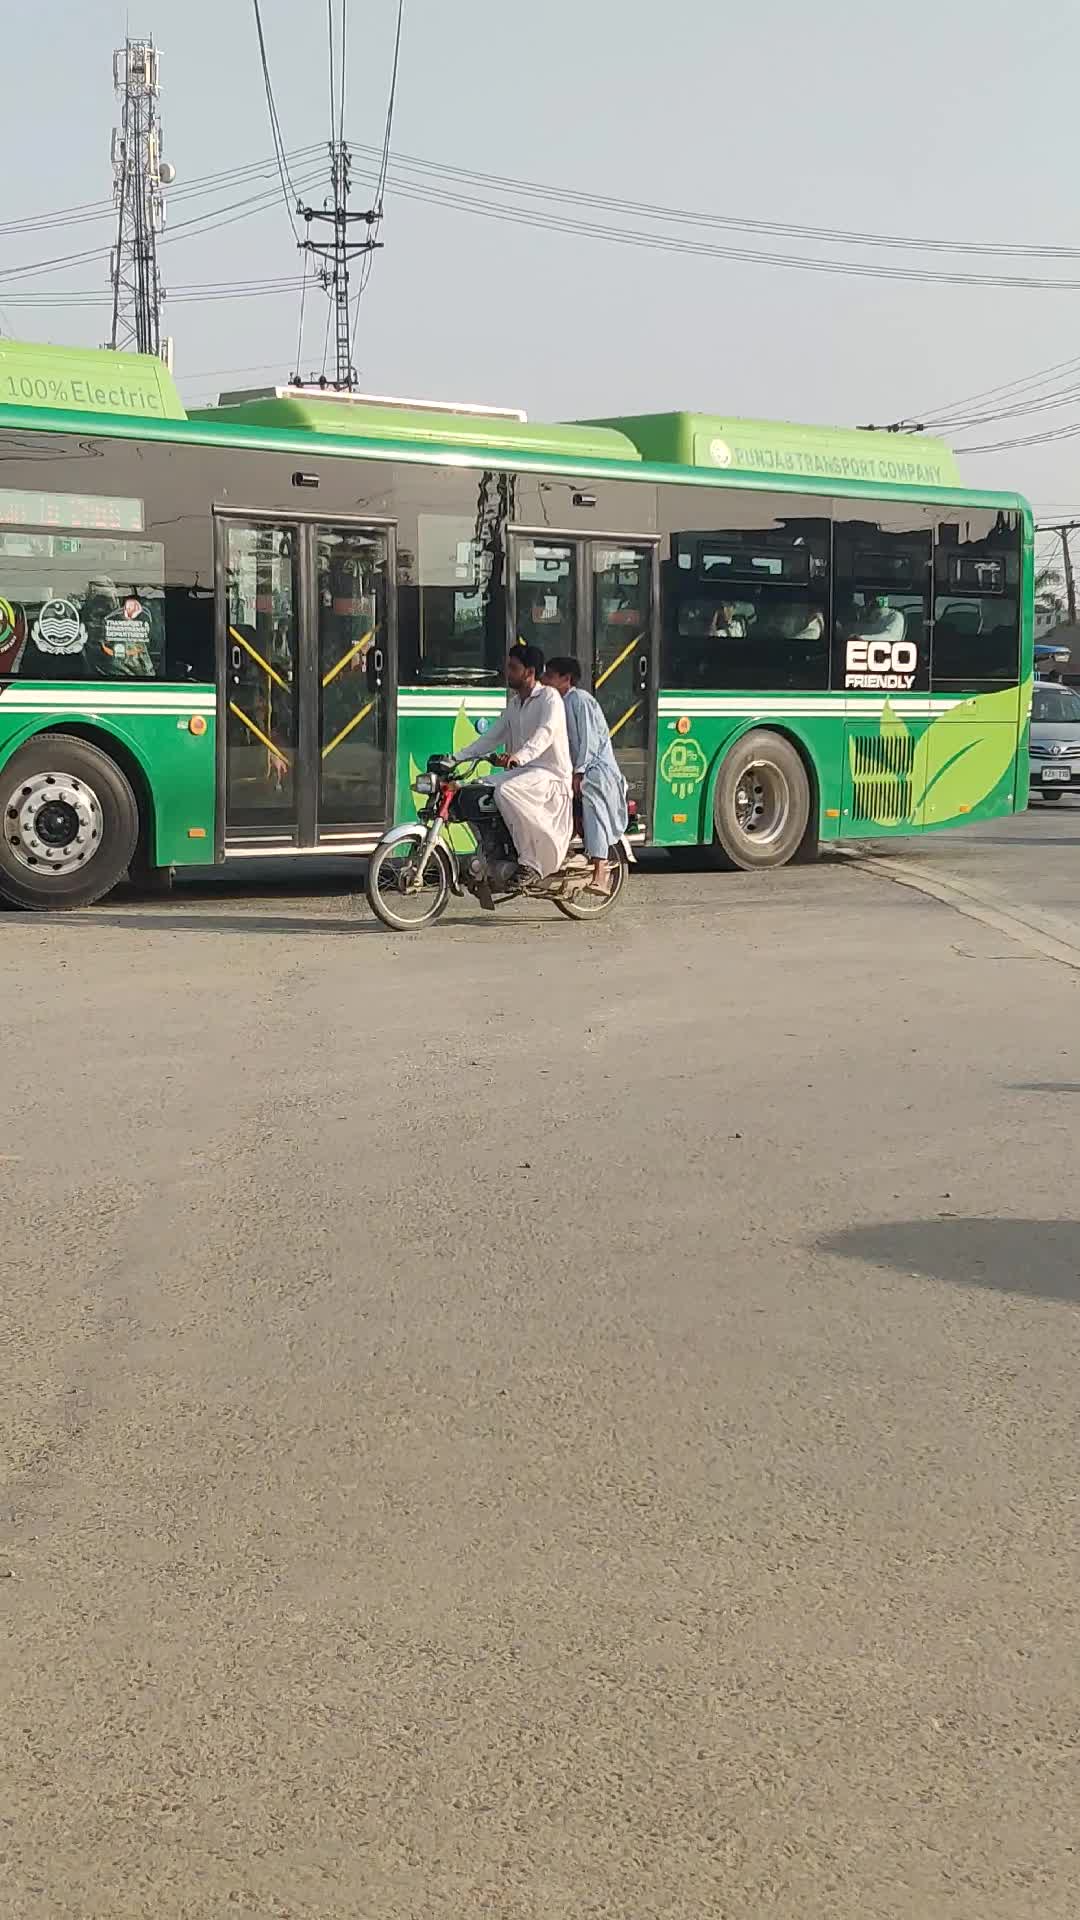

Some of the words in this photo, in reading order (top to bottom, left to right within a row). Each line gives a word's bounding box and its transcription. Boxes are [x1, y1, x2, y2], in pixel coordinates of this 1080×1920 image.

[8, 376, 68, 401] 100%
[71, 381, 159, 409] Electric
[735, 447, 795, 471] PUNJAB
[797, 452, 876, 478] TRANSPORT
[880, 461, 943, 484] COMPANY
[846, 640, 917, 672] ECO
[845, 674, 916, 689] FRIENDLY
